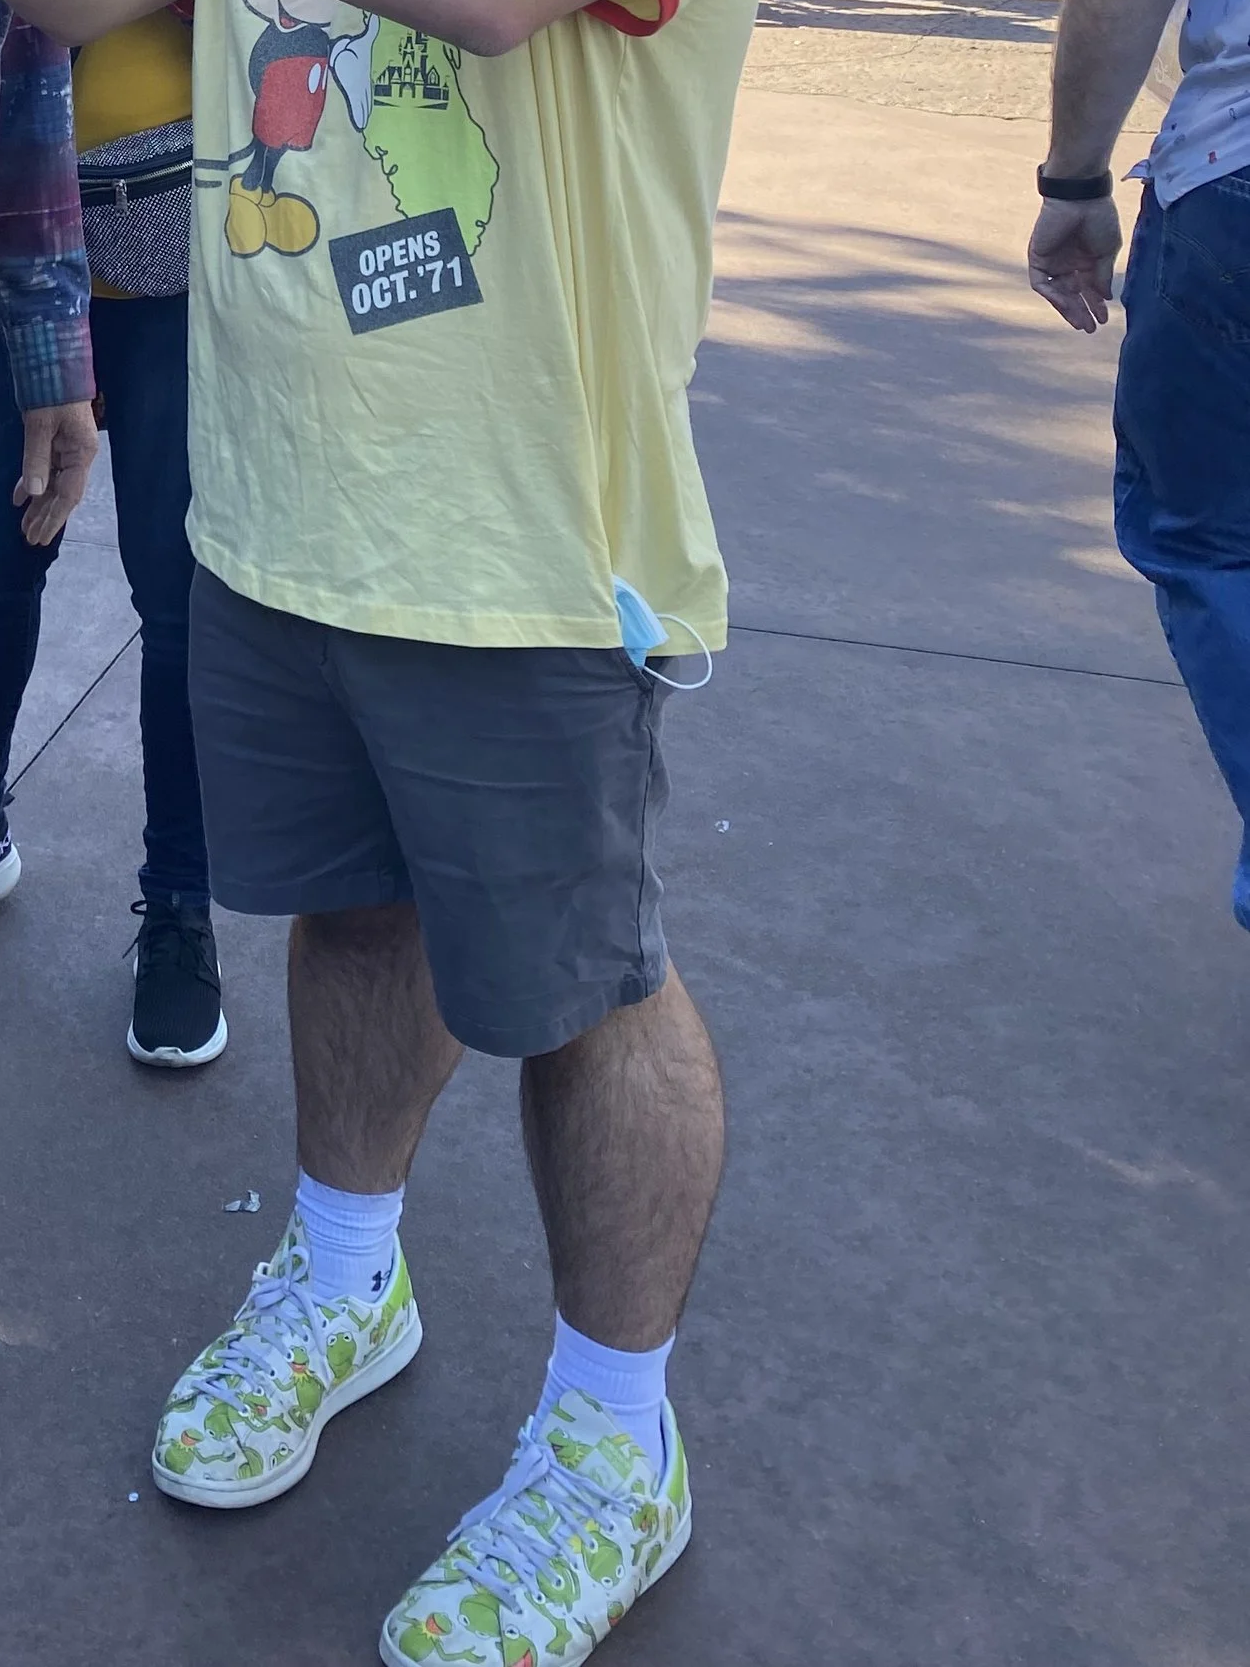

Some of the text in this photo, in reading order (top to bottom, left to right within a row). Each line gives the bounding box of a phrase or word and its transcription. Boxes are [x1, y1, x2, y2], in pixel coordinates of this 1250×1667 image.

[359, 230, 441, 276] OPENS
[351, 256, 463, 314] OCT. '71
